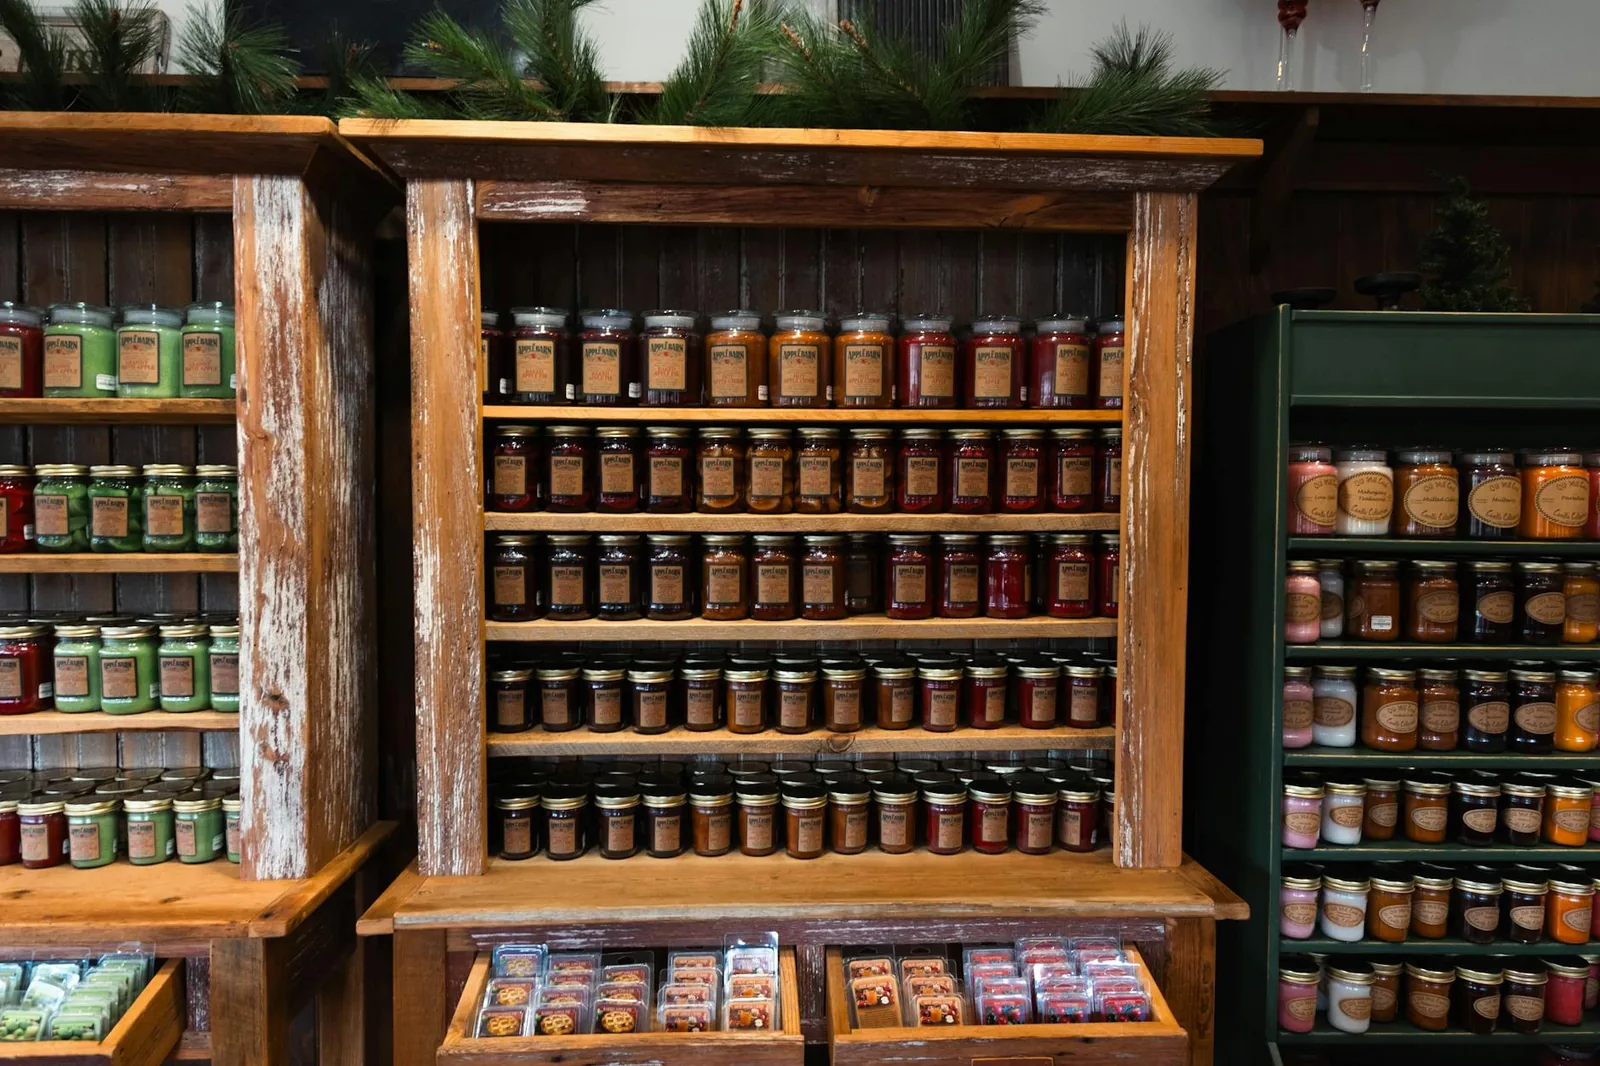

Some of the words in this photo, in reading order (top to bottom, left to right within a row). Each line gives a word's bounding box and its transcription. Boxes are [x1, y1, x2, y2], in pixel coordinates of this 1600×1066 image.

[46, 338, 61, 350] APPLE
[61, 340, 78, 350] BARN
[121, 334, 137, 346] APPLE
[137, 336, 155, 346] BARN
[185, 336, 200, 348] APPLE
[200, 338, 218, 346] BARN
[518, 343, 534, 354] APPLE
[536, 346, 552, 354] BARN
[585, 346, 601, 357] APPLE
[602, 348, 617, 356] BARN
[650, 341, 668, 352] APPLE
[668, 343, 684, 352] BARN
[712, 348, 728, 361] APPLE
[728, 350, 744, 360] BARN
[783, 348, 800, 361] APPLE
[800, 350, 816, 360] BARN
[848, 348, 865, 360] APPLE
[865, 350, 880, 360] BARN
[924, 349, 941, 361] APPLE
[941, 351, 953, 360] BARN
[978, 350, 994, 361] APPLE
[994, 352, 1010, 360] BARN
